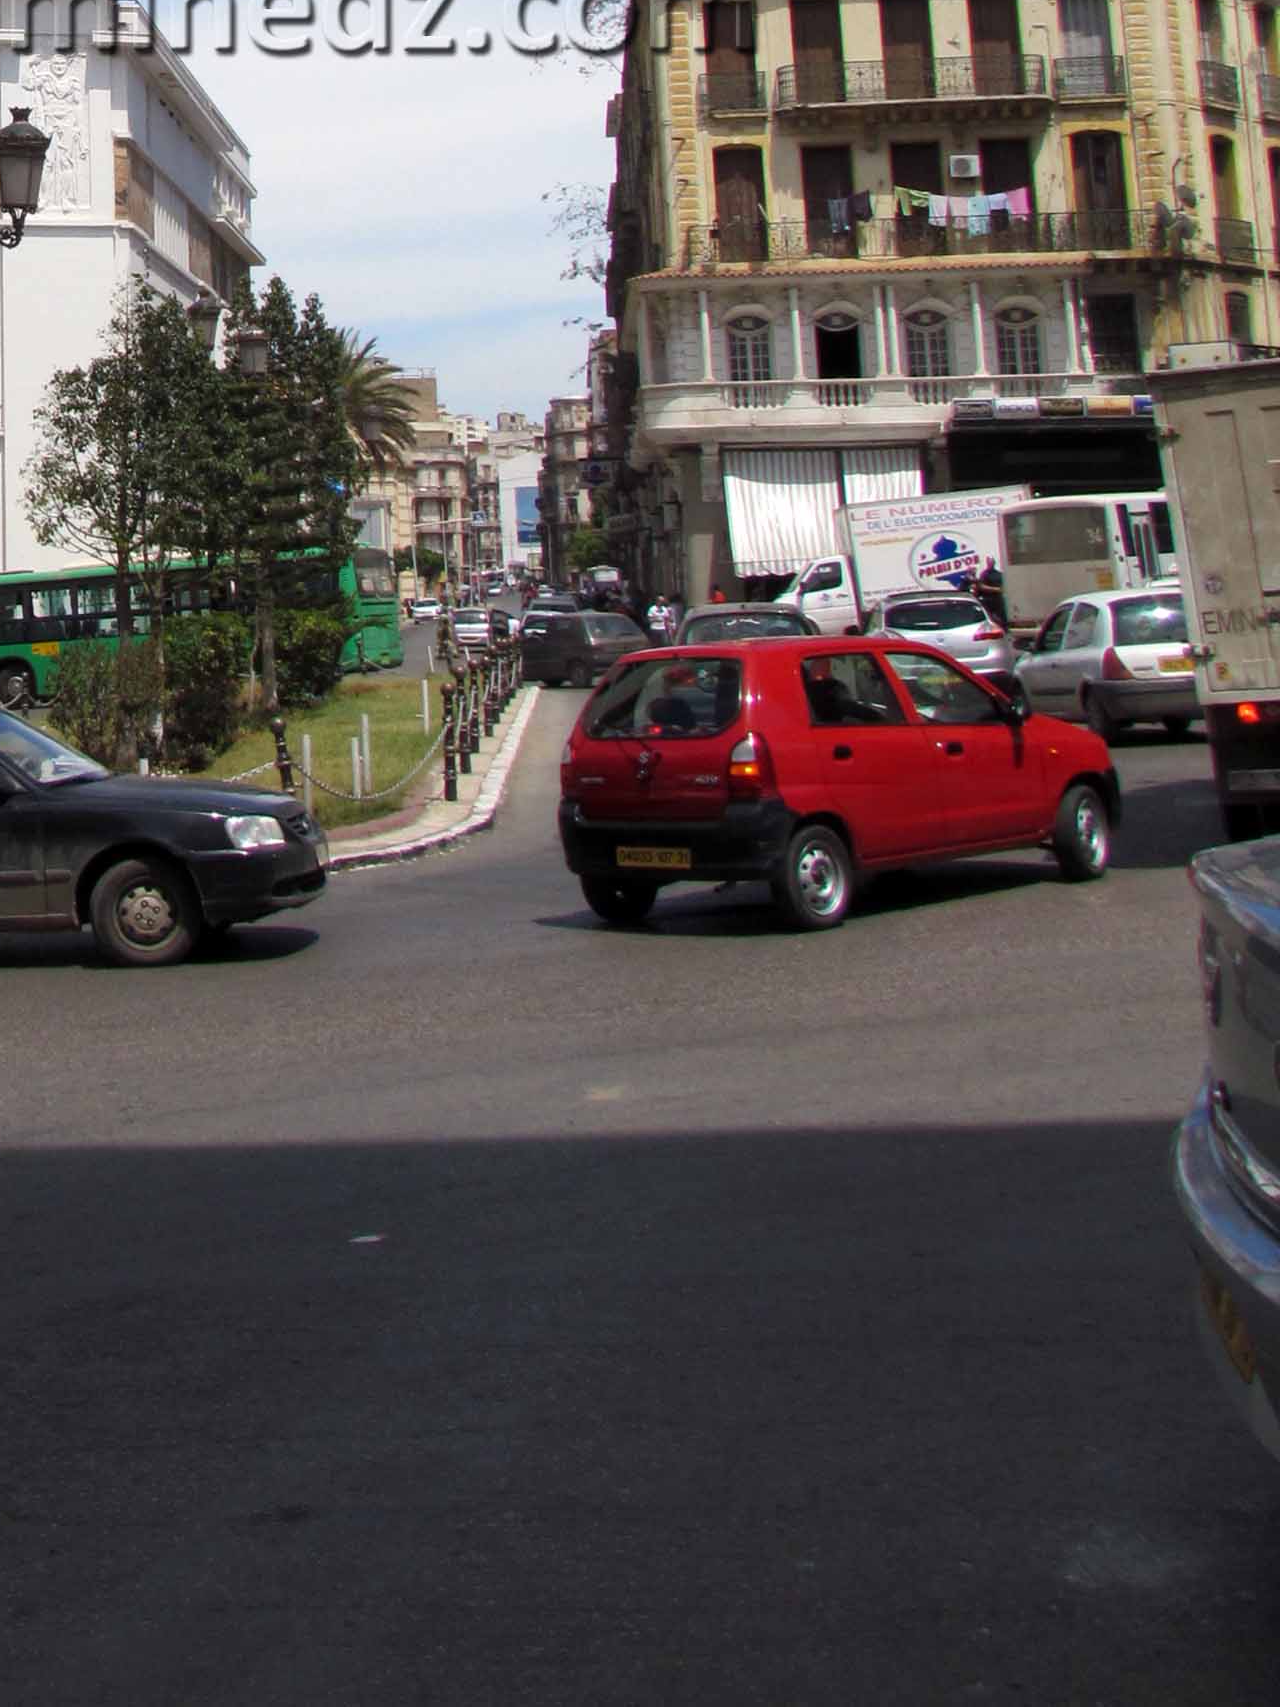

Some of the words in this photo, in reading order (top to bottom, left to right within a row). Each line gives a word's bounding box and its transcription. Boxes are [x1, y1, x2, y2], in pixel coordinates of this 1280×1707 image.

[850, 507, 881, 522] LE
[888, 495, 1004, 517] NUMERO
[867, 520, 882, 531] DE
[919, 561, 951, 578] PALAIS
[954, 554, 980, 570] D'OR
